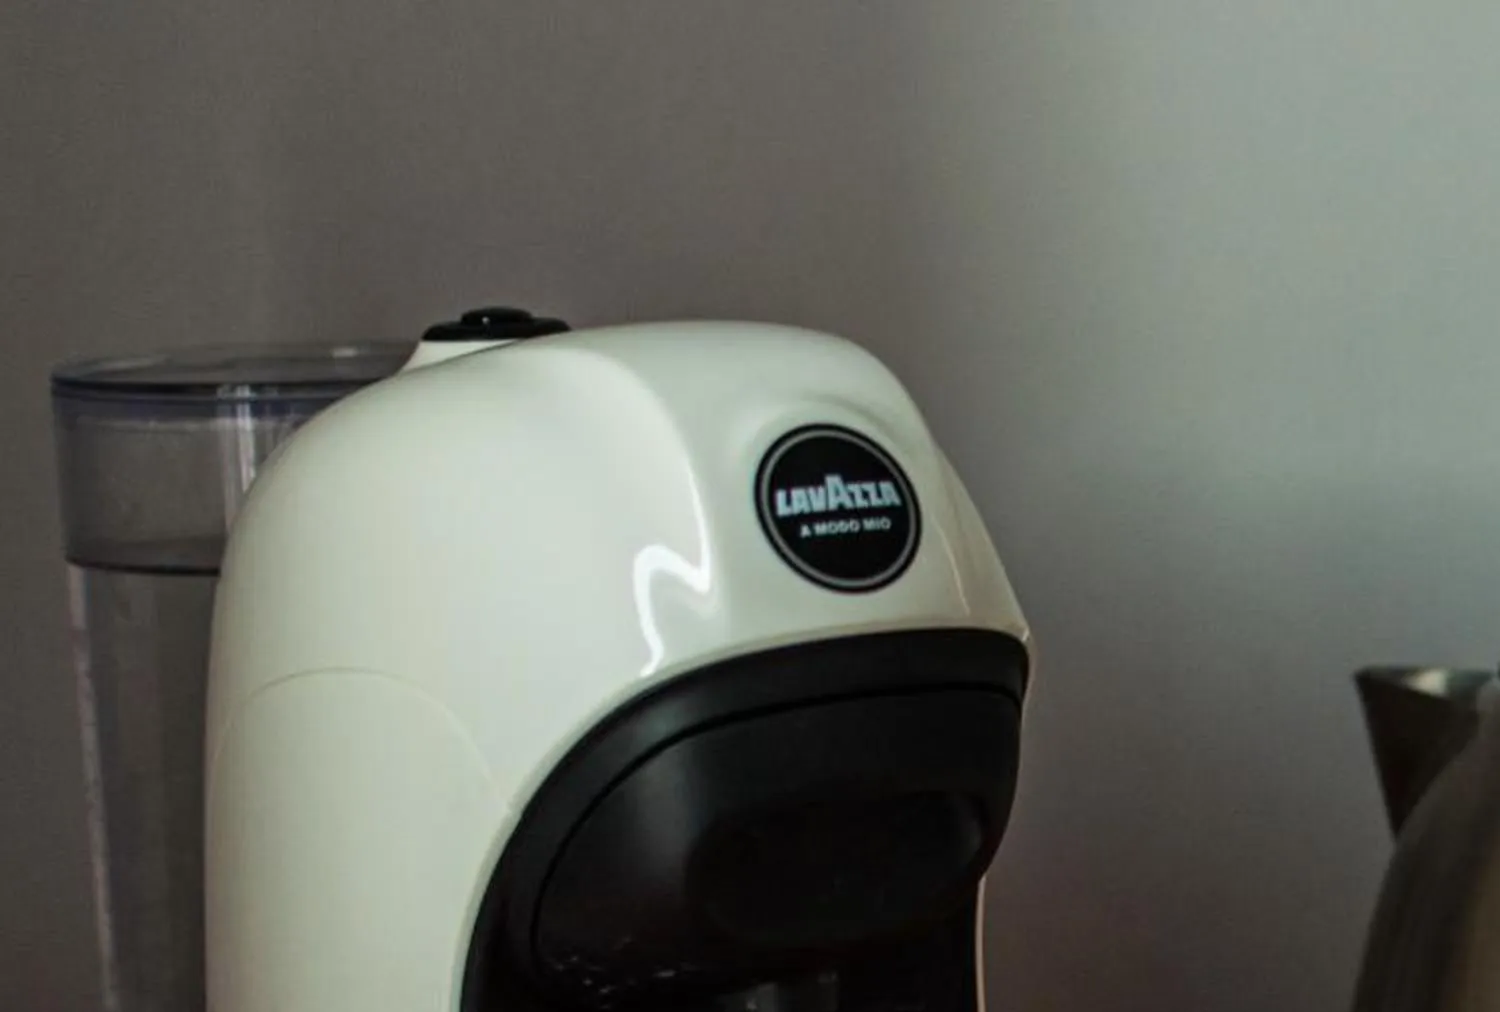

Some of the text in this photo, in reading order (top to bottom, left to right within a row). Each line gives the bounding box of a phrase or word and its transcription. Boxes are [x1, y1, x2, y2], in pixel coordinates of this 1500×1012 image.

[776, 475, 901, 518] LAVAZZA
[800, 517, 892, 538] A MODO MIO
